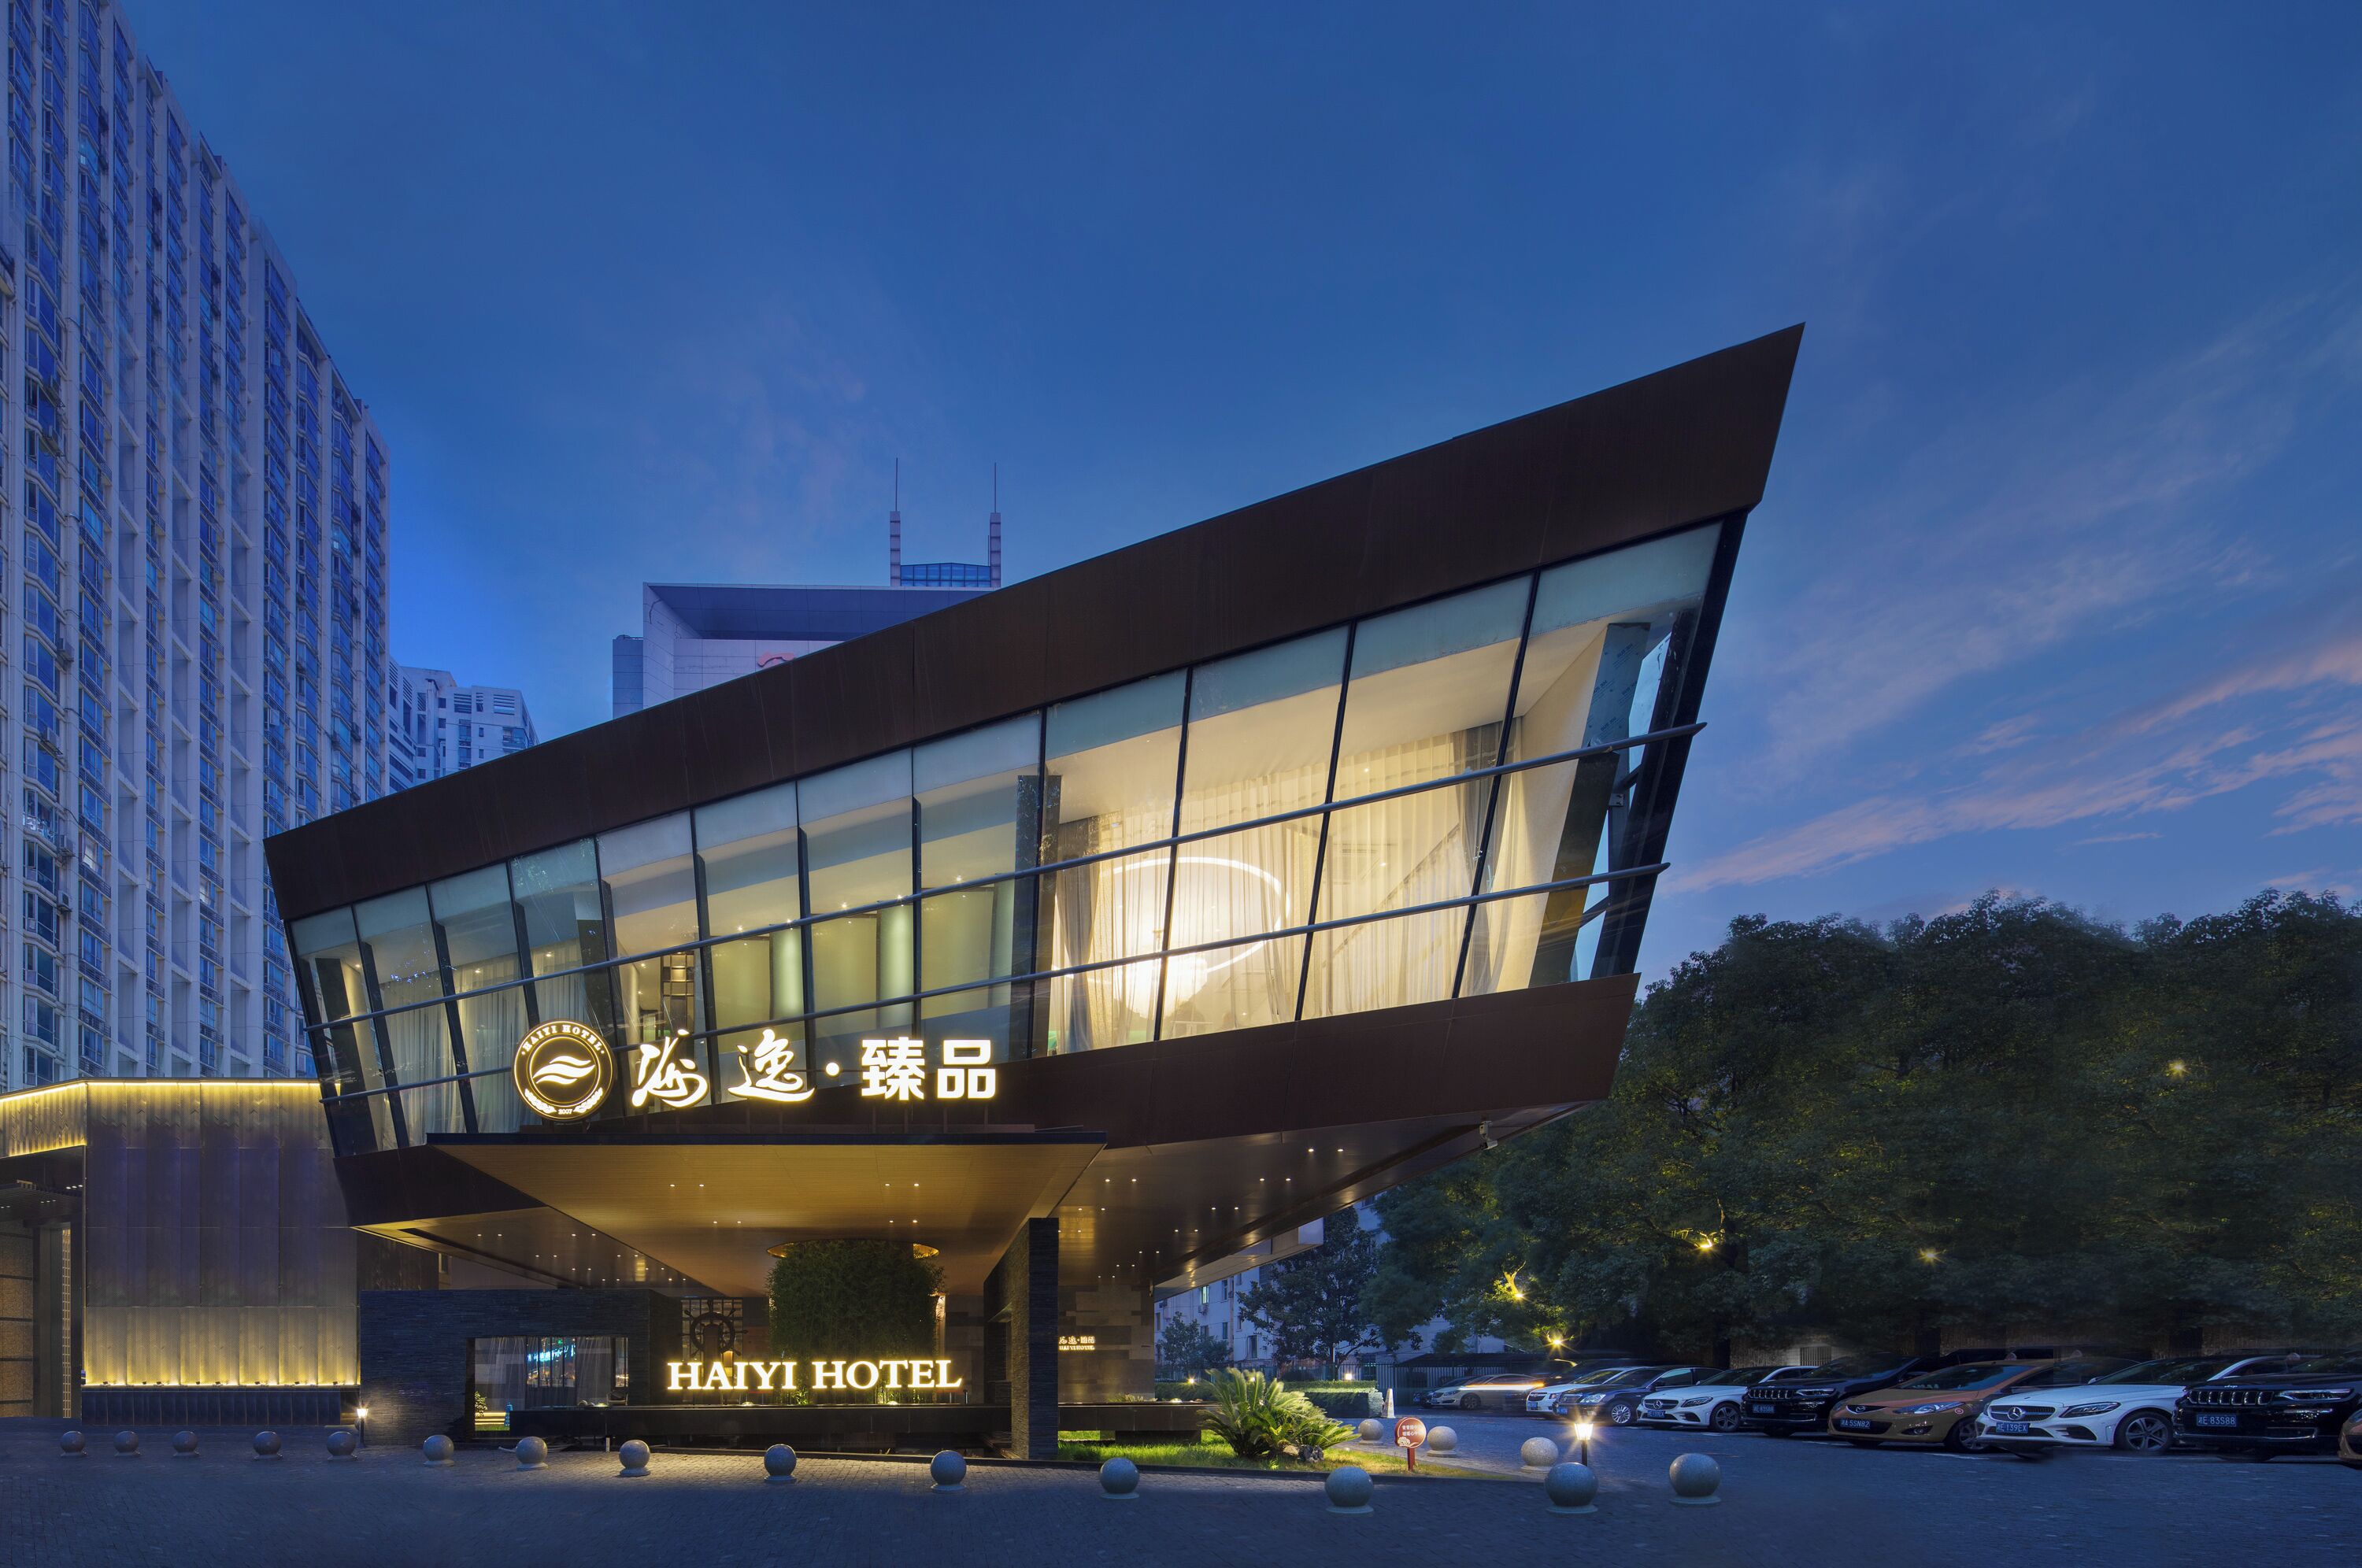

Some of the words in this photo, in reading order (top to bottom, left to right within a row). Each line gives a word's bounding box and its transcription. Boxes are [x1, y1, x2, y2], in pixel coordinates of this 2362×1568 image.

[522, 1025, 557, 1052] HAIYI
[562, 1024, 602, 1051] HOTEL
[667, 1361, 797, 1390] HAIYI
[812, 1359, 963, 1389] HOTEL
[2210, 1416, 2236, 1425] 83S88
